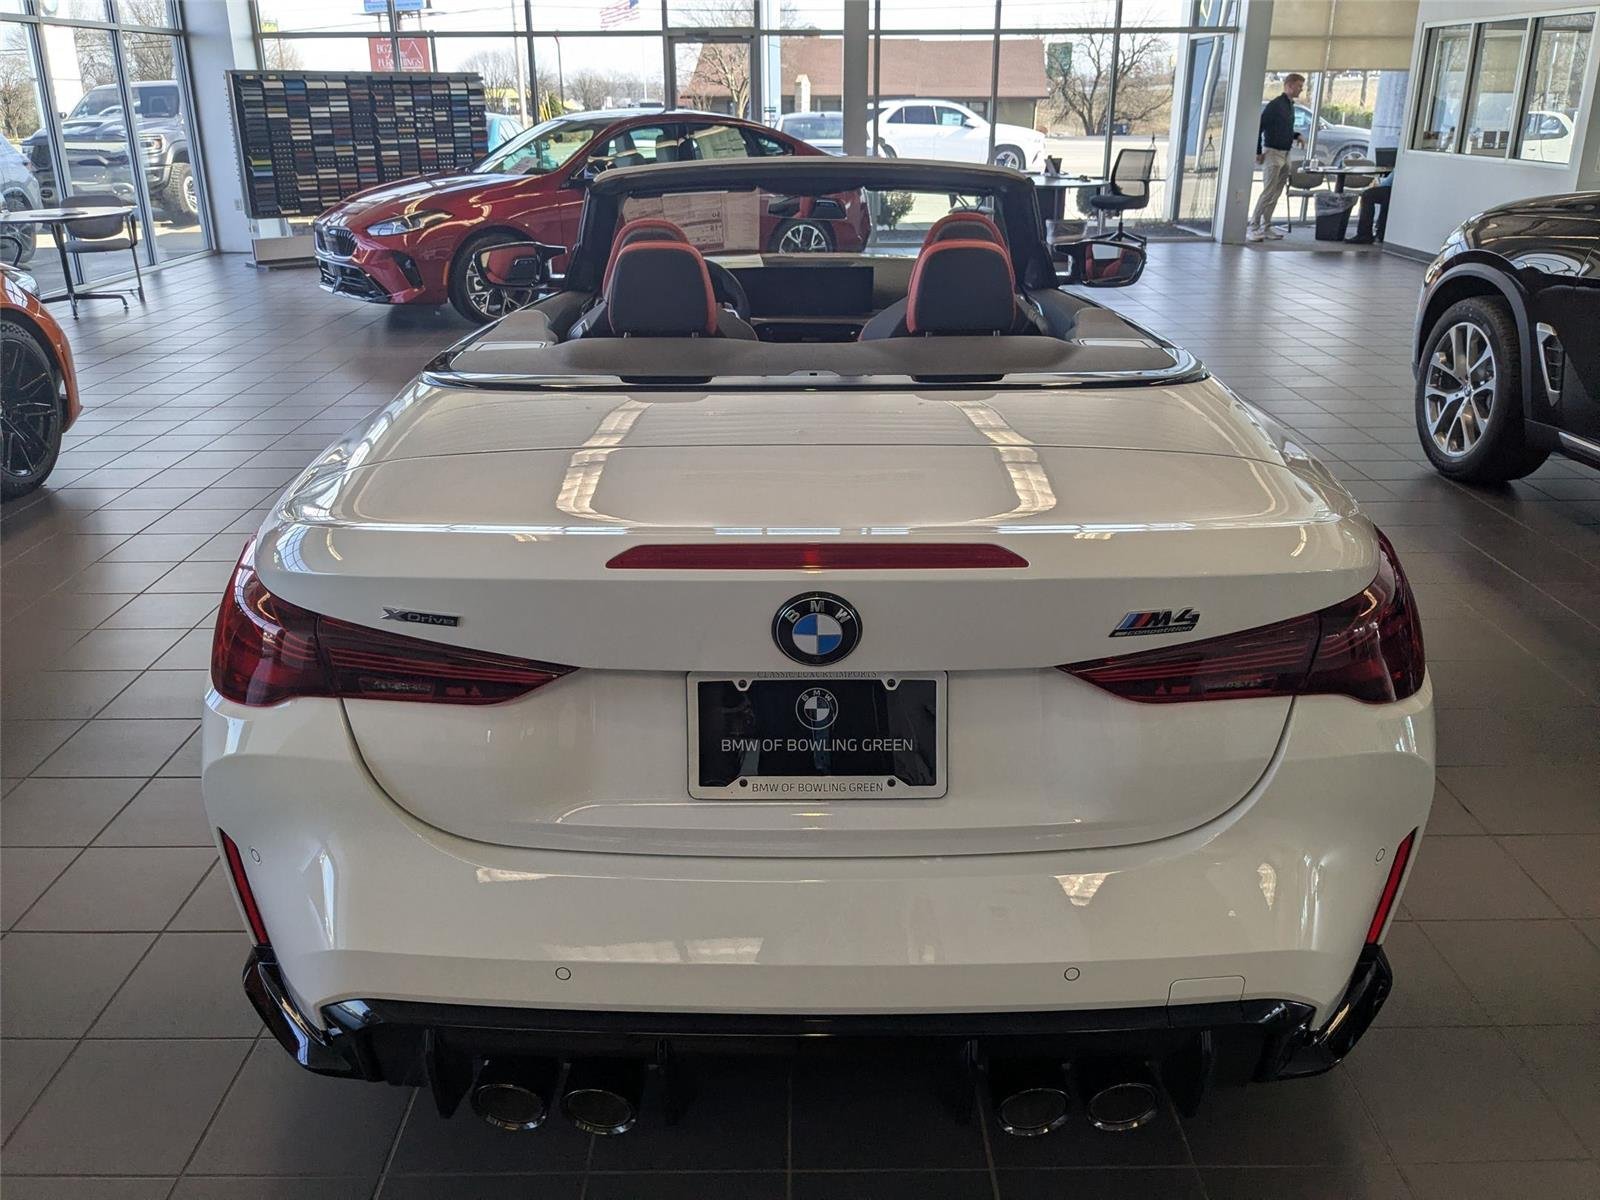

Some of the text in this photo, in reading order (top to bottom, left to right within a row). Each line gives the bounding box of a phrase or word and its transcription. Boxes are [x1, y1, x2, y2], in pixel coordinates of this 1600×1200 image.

[784, 600, 851, 623] BMW
[801, 690, 833, 702] BMW
[721, 738, 913, 752] BMW OF BOWLING GREEN
[751, 782, 884, 793] BMW OF BOWLING GREEN
